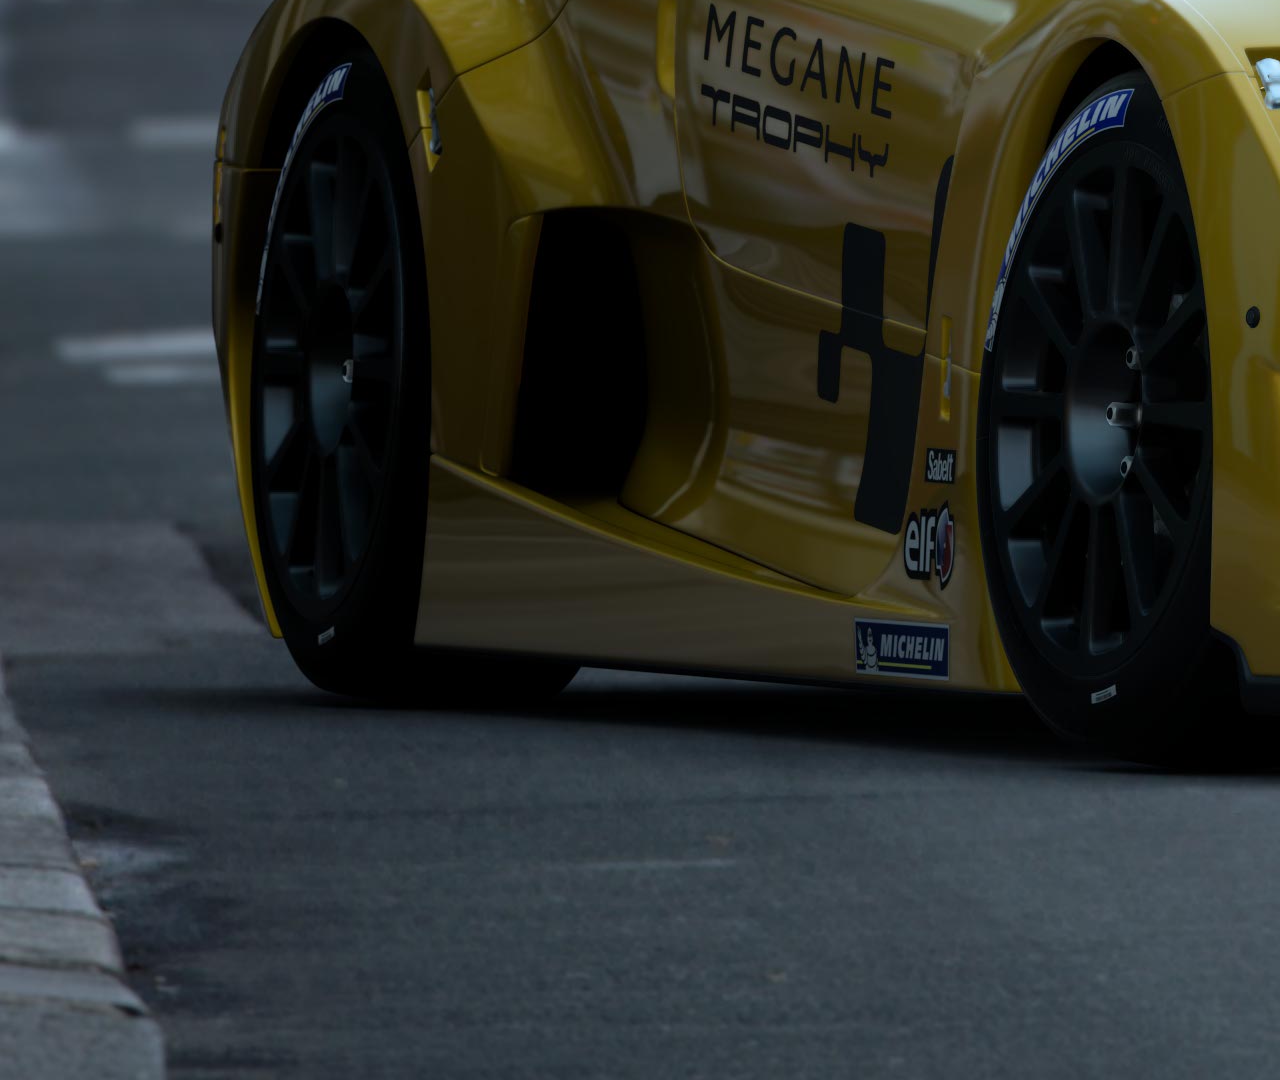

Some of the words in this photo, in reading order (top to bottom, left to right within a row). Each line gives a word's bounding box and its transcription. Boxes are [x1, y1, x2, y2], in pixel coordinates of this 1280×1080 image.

[703, 2, 896, 120] MEGANE
[700, 83, 889, 179] TROPHY
[1003, 92, 1128, 265] MICHELIN
[926, 449, 954, 482] Sabelt
[904, 513, 937, 573] elf
[879, 633, 945, 662] MICHELIN
